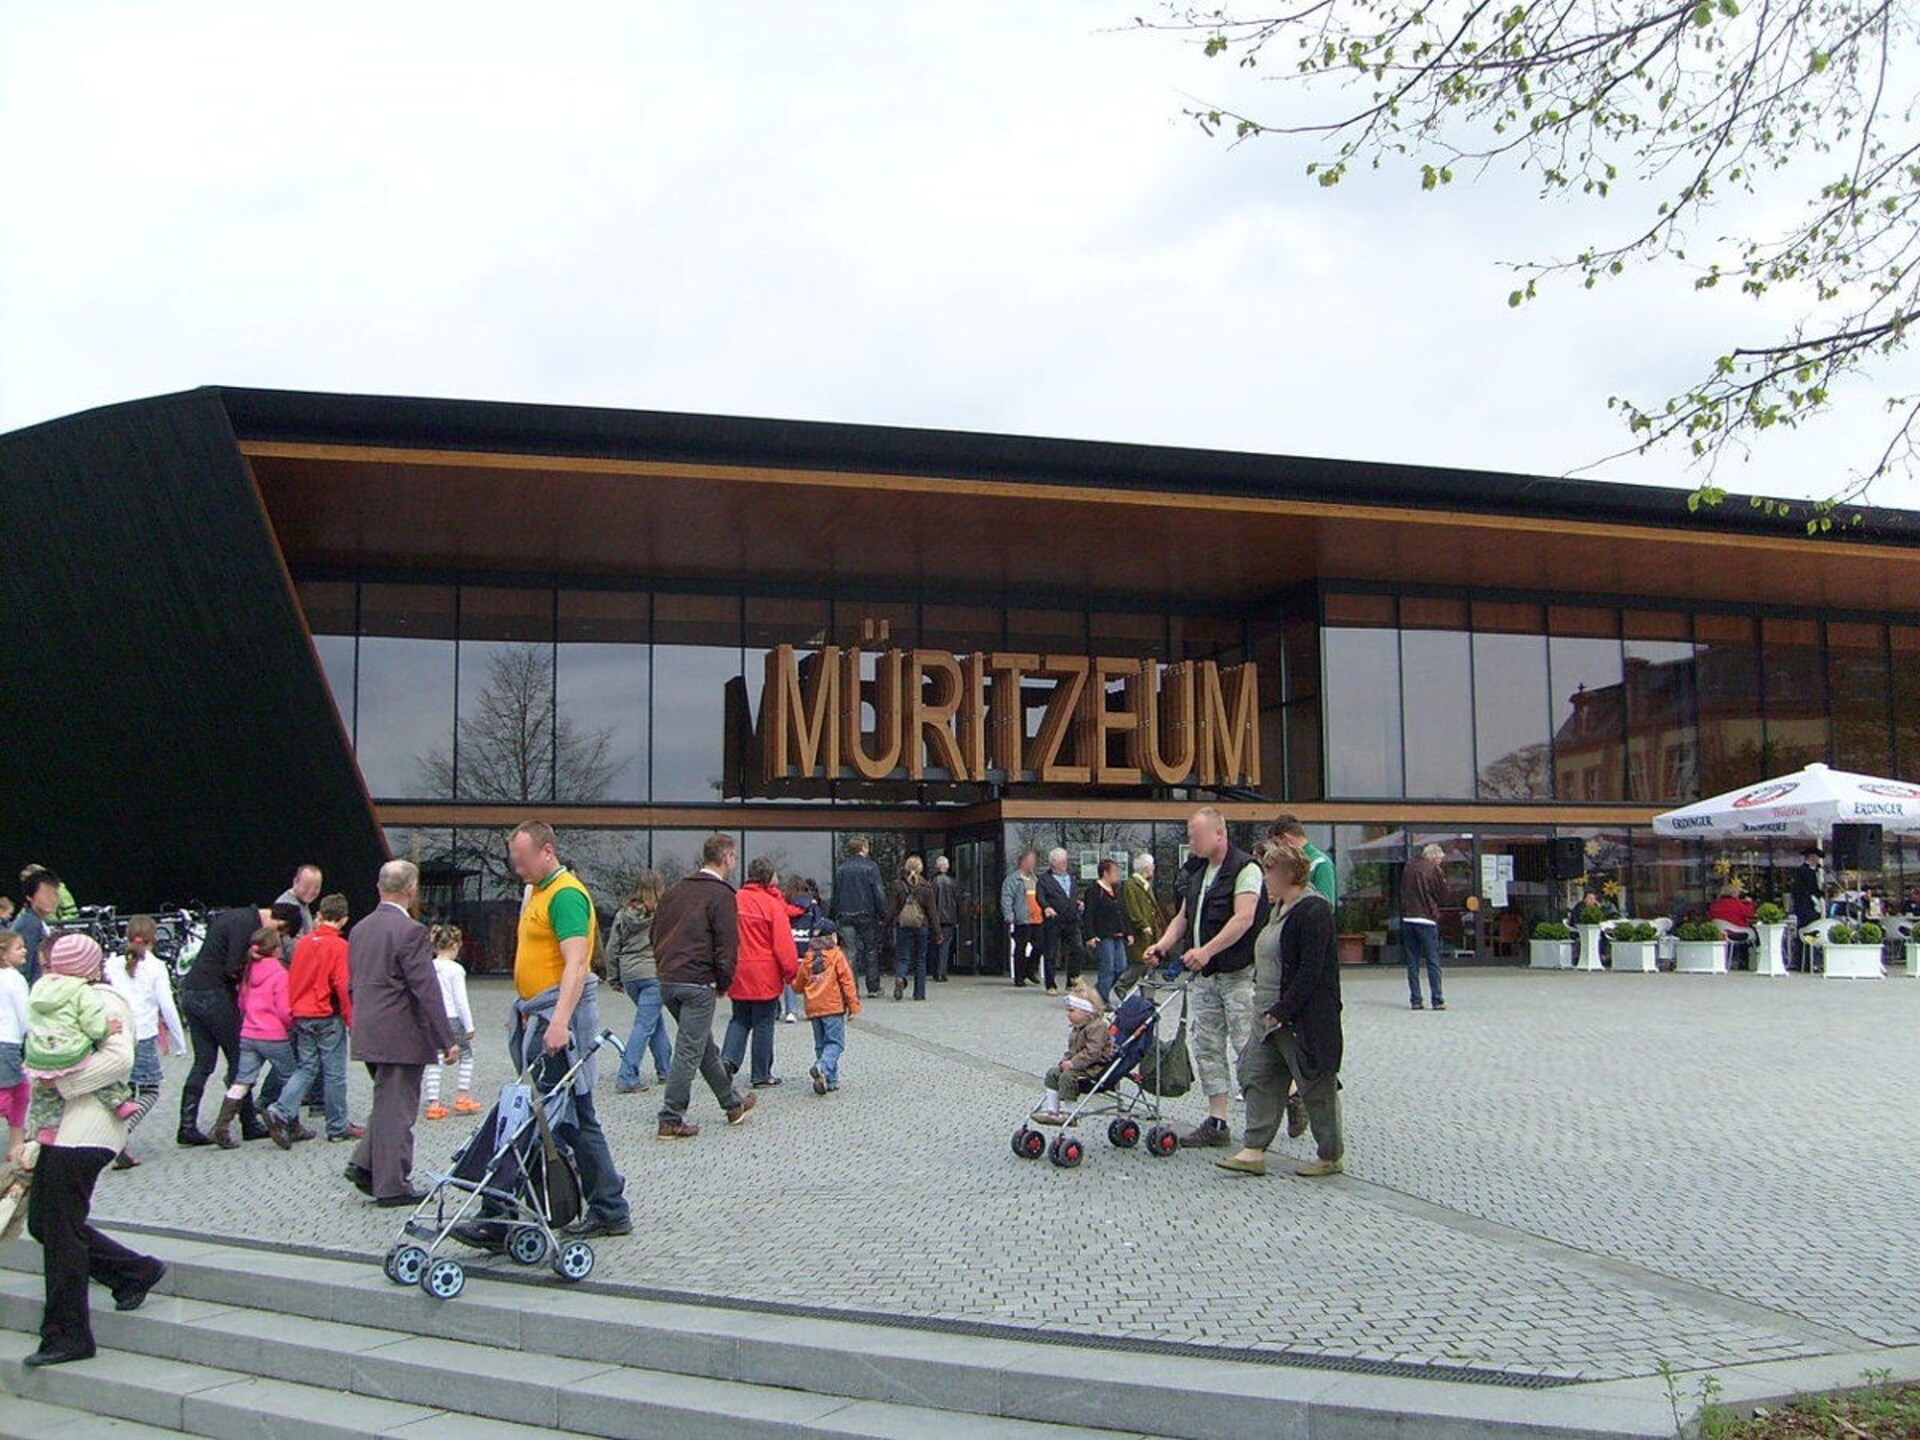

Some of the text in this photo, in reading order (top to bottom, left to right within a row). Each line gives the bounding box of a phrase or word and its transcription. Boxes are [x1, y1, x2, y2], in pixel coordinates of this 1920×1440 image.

[770, 618, 1261, 786] MÜRITZEUM
[1853, 802, 1904, 816] ERDINGER
[1671, 815, 1714, 830] ERDINGER
